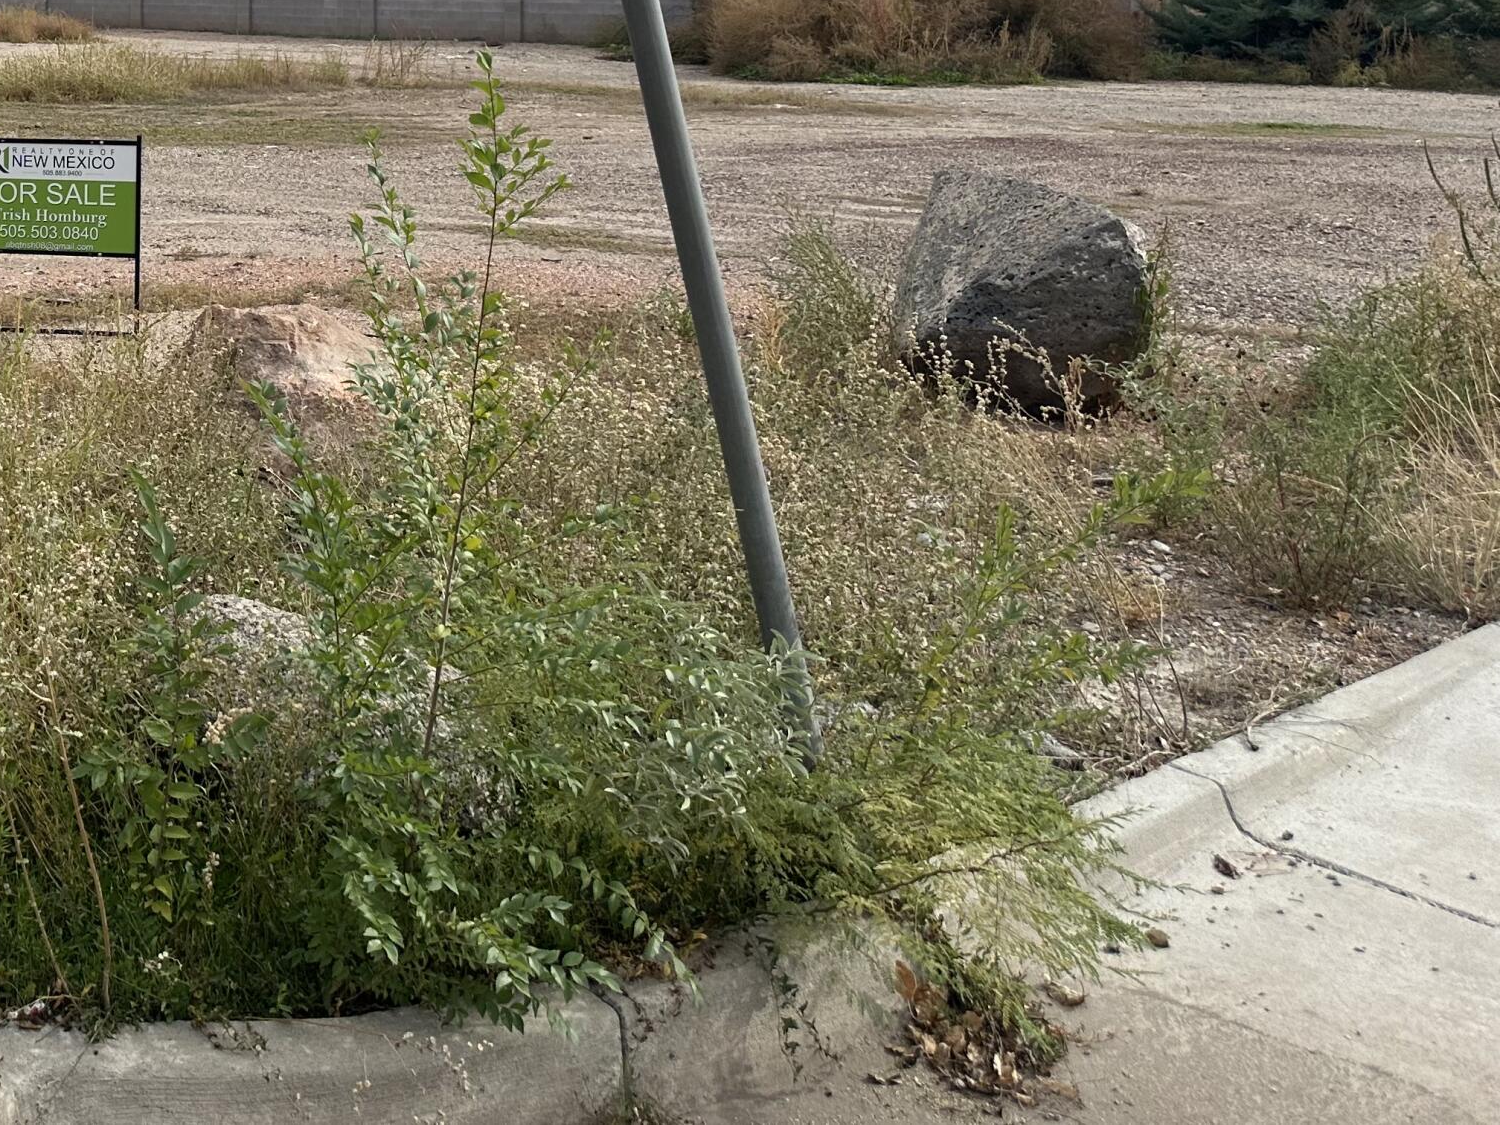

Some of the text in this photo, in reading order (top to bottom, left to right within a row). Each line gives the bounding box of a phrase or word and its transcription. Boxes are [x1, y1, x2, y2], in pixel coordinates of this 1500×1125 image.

[12, 146, 62, 155] REALTY
[12, 155, 115, 170] NEW MEXICO
[46, 183, 116, 206] SALE
[36, 208, 108, 228] Homburg
[0, 224, 99, 240] 505.503.0840
